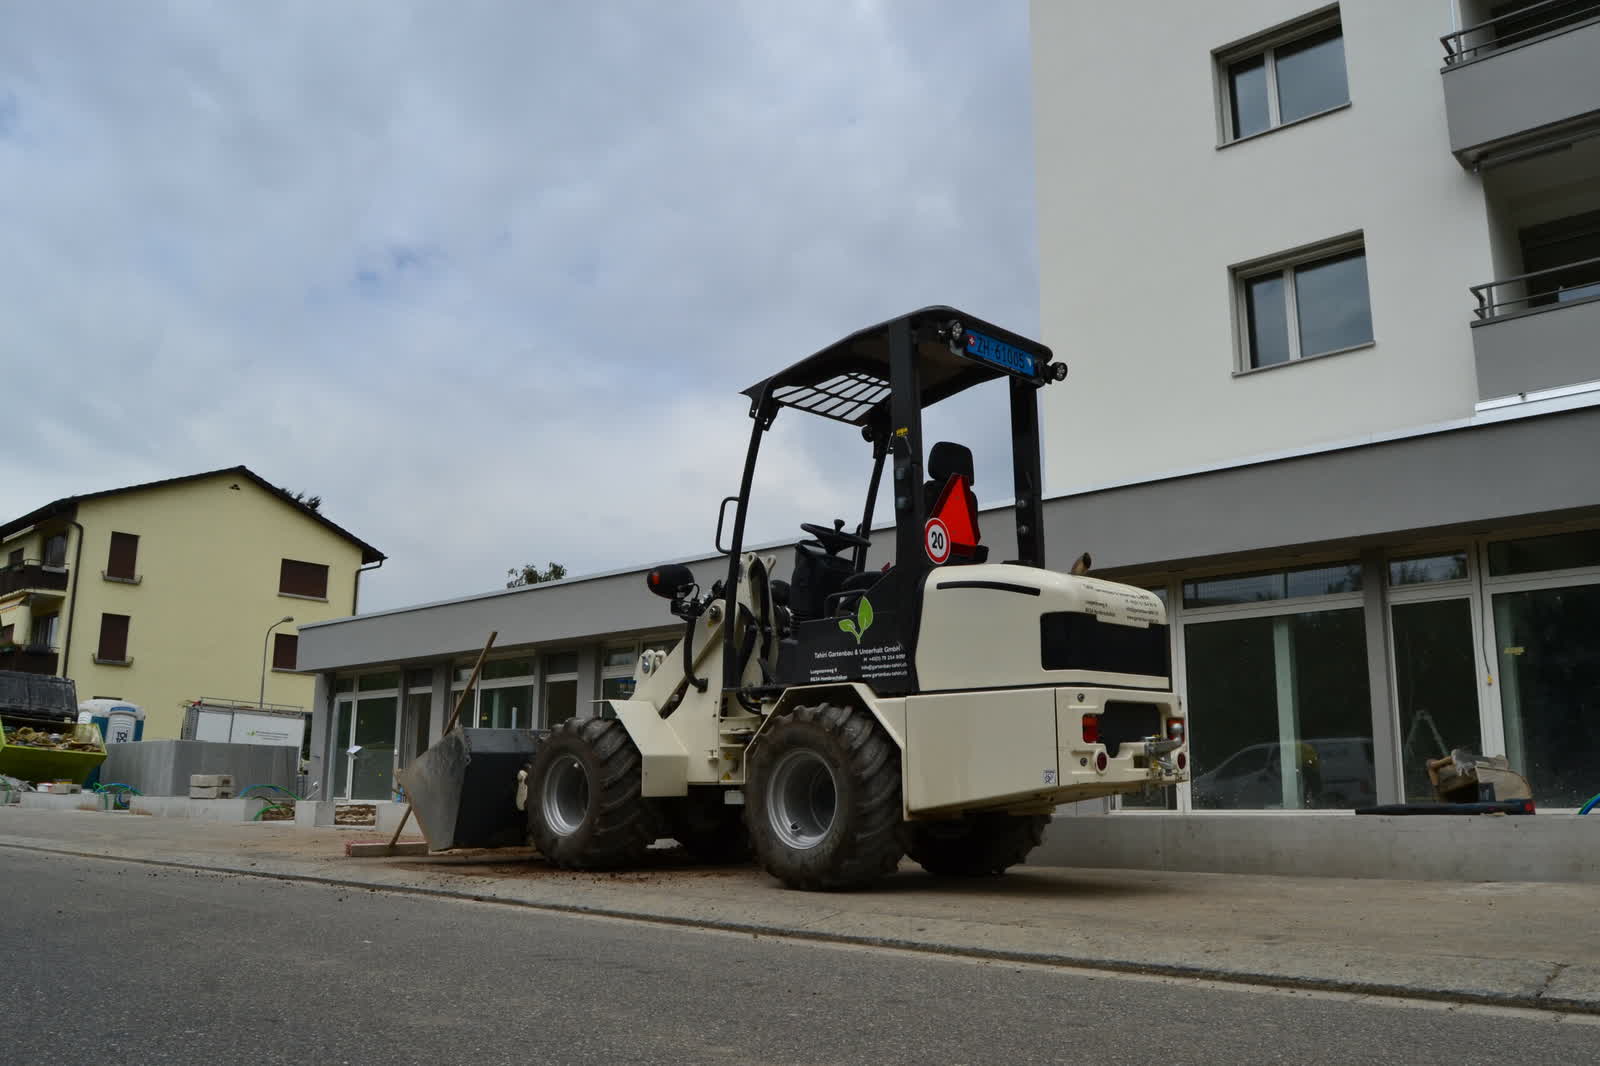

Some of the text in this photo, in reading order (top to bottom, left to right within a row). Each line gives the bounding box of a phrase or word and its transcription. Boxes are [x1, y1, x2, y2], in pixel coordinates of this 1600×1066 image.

[931, 531, 944, 550] 20
[828, 650, 854, 658] Gartenbau
[884, 645, 900, 653] GmbH
